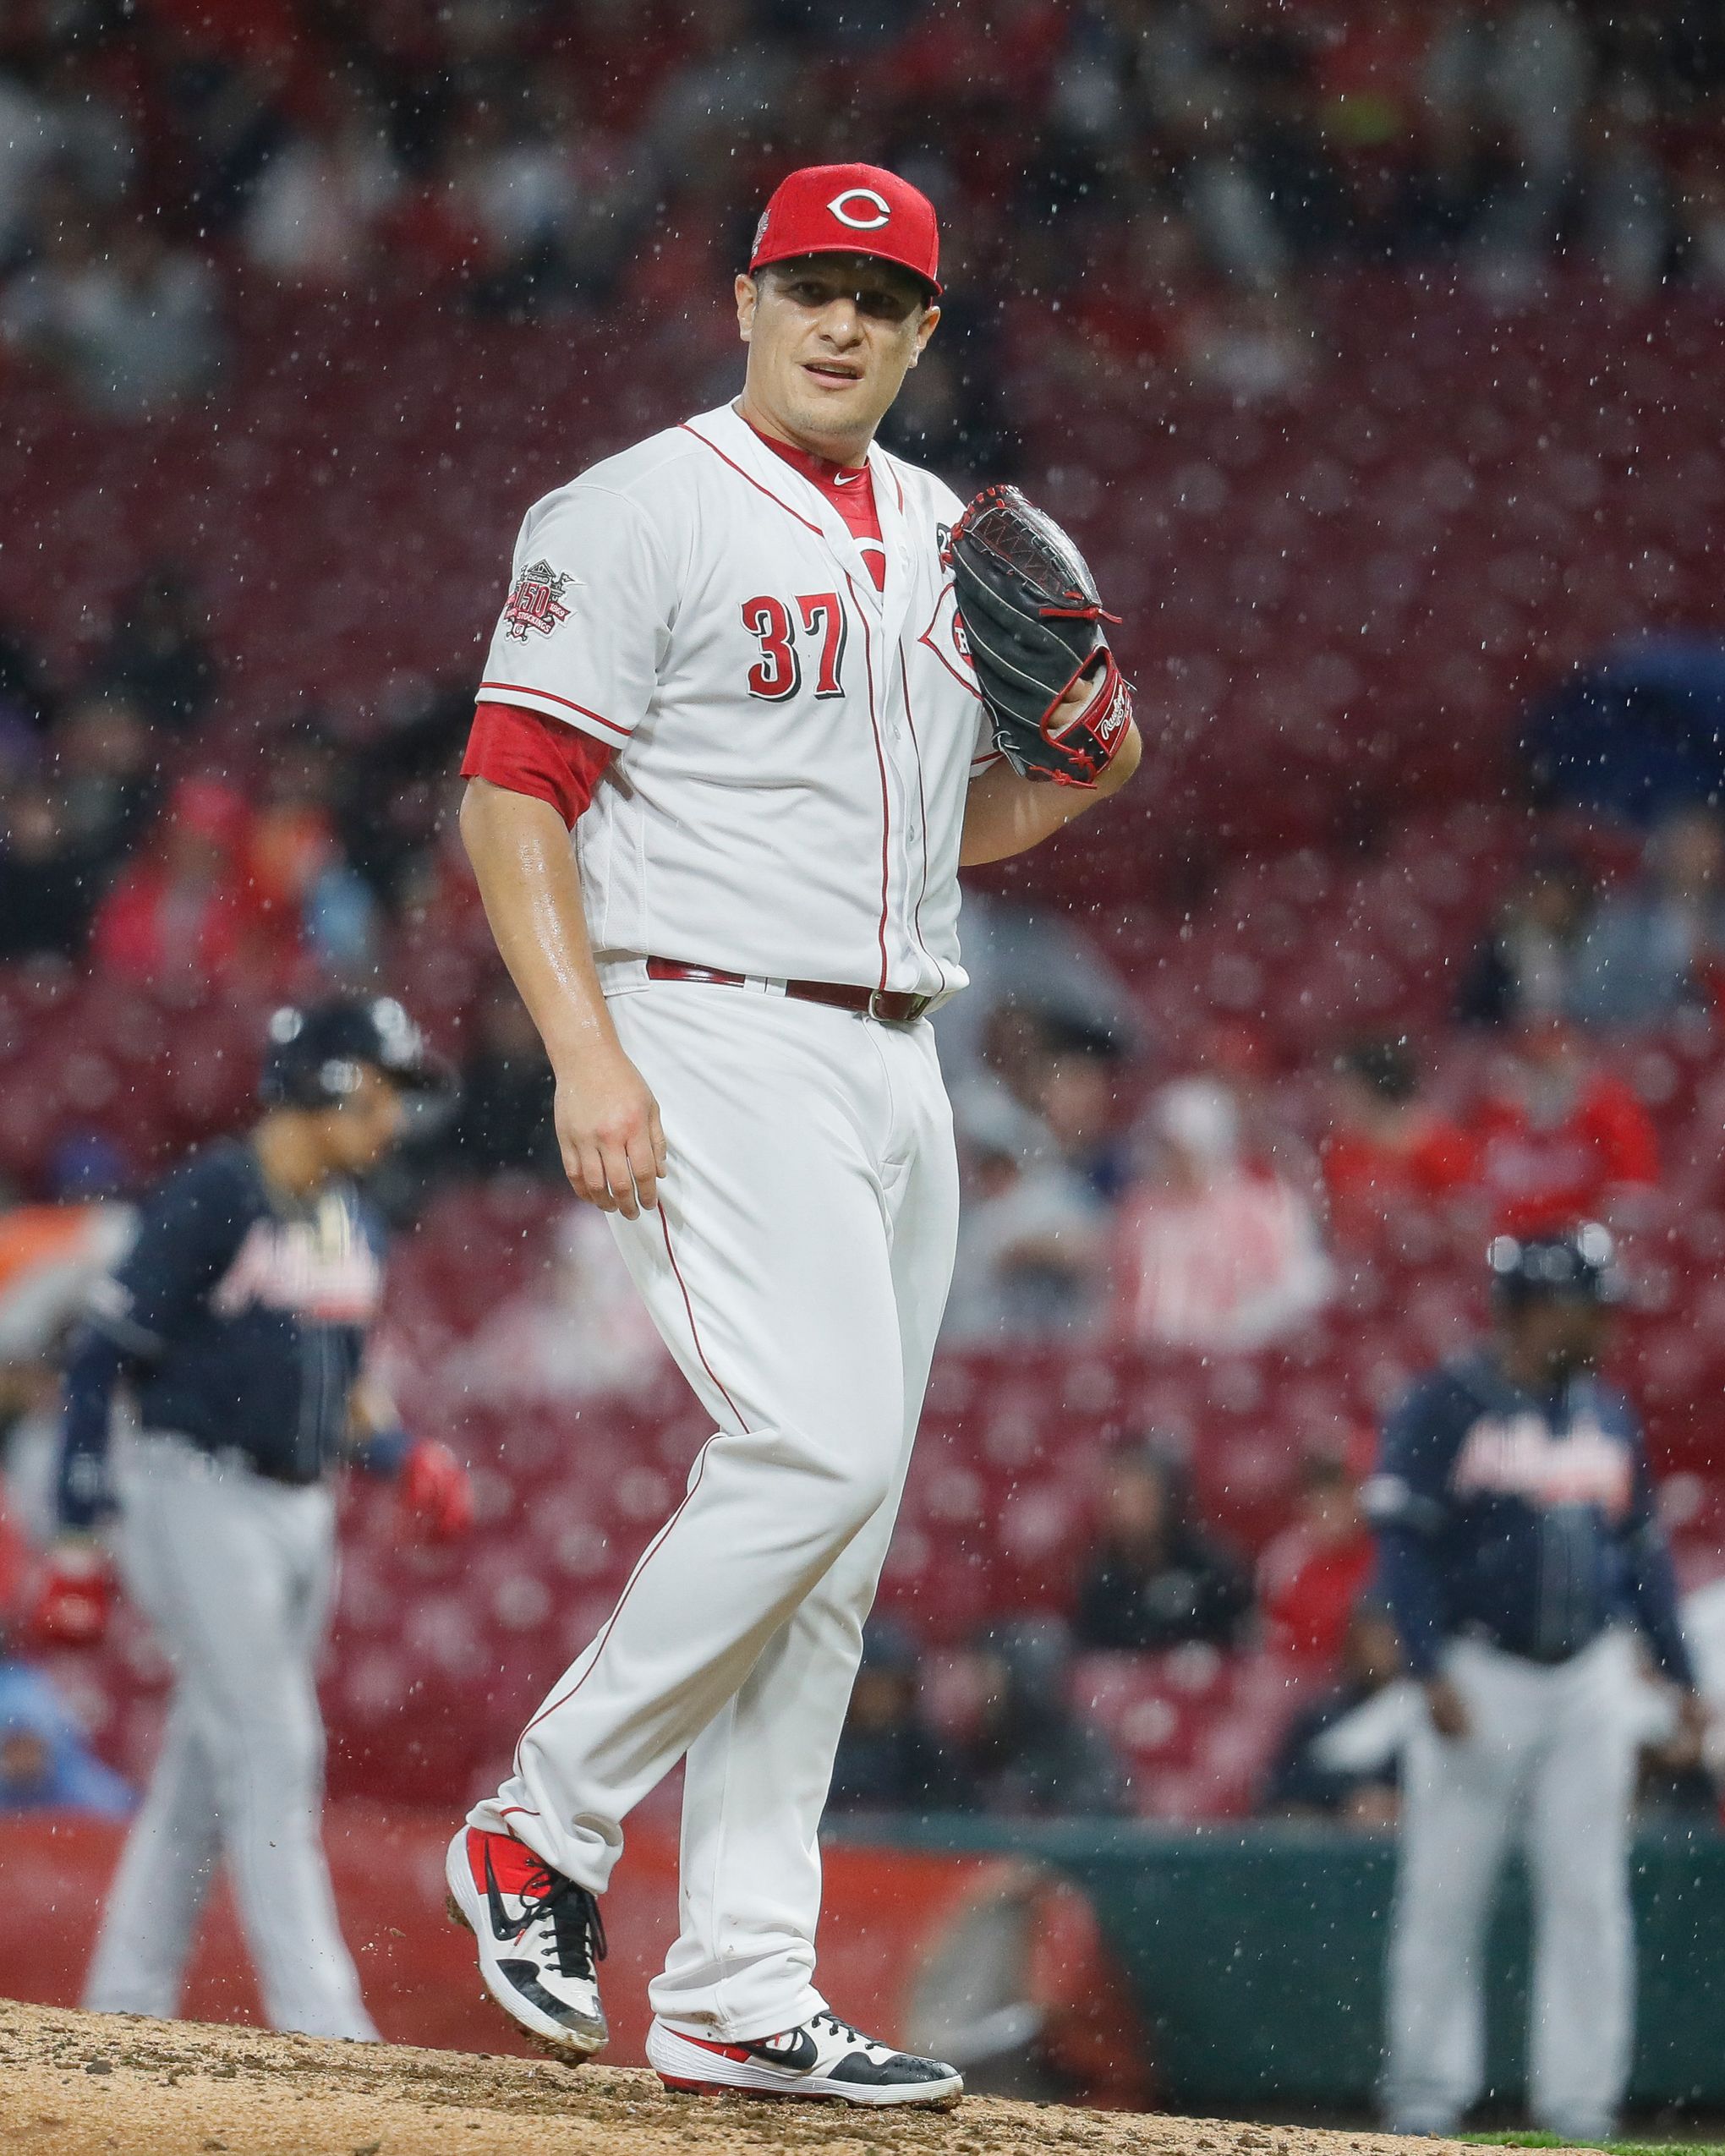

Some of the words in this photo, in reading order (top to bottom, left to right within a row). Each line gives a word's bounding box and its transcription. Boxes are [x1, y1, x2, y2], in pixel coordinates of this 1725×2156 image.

[826, 188, 891, 231] C
[514, 582, 551, 618] 150
[549, 603, 566, 617] 1869
[516, 611, 551, 632] STOCKINGS
[738, 591, 848, 703] 37
